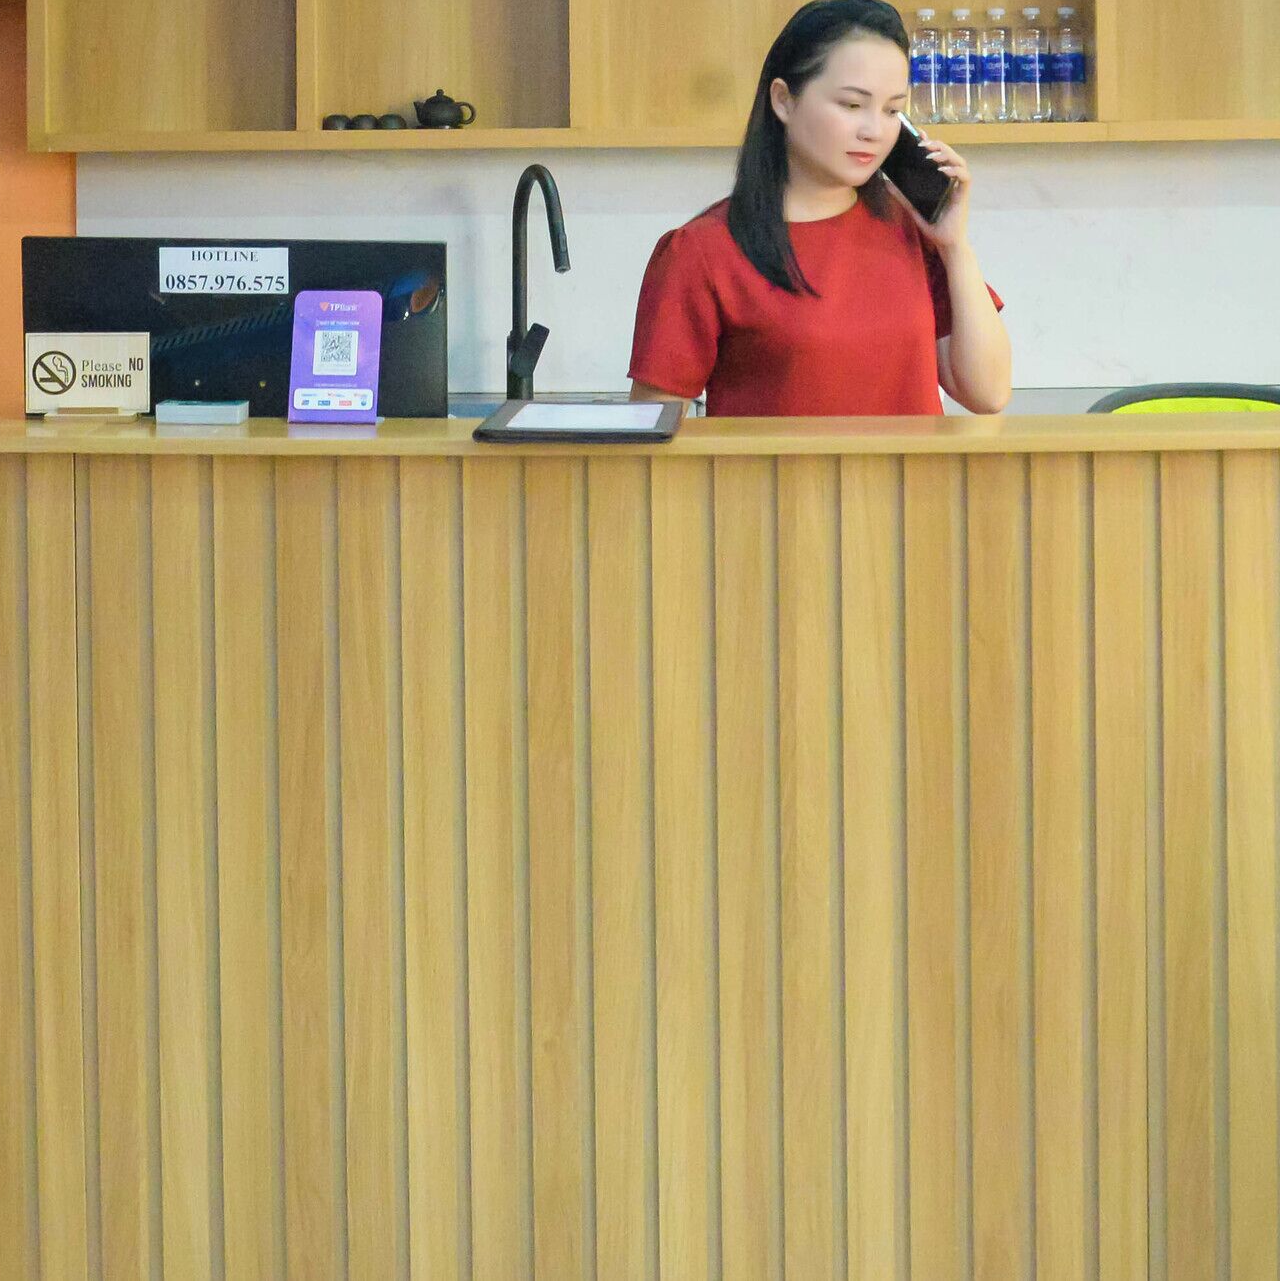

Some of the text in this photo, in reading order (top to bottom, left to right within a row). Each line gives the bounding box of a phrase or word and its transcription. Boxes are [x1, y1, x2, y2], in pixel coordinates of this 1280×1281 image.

[191, 250, 259, 263] HOTLINE
[165, 274, 286, 292] 0857.976.575
[81, 357, 144, 372] Please NO
[81, 374, 132, 388] SMOKING
